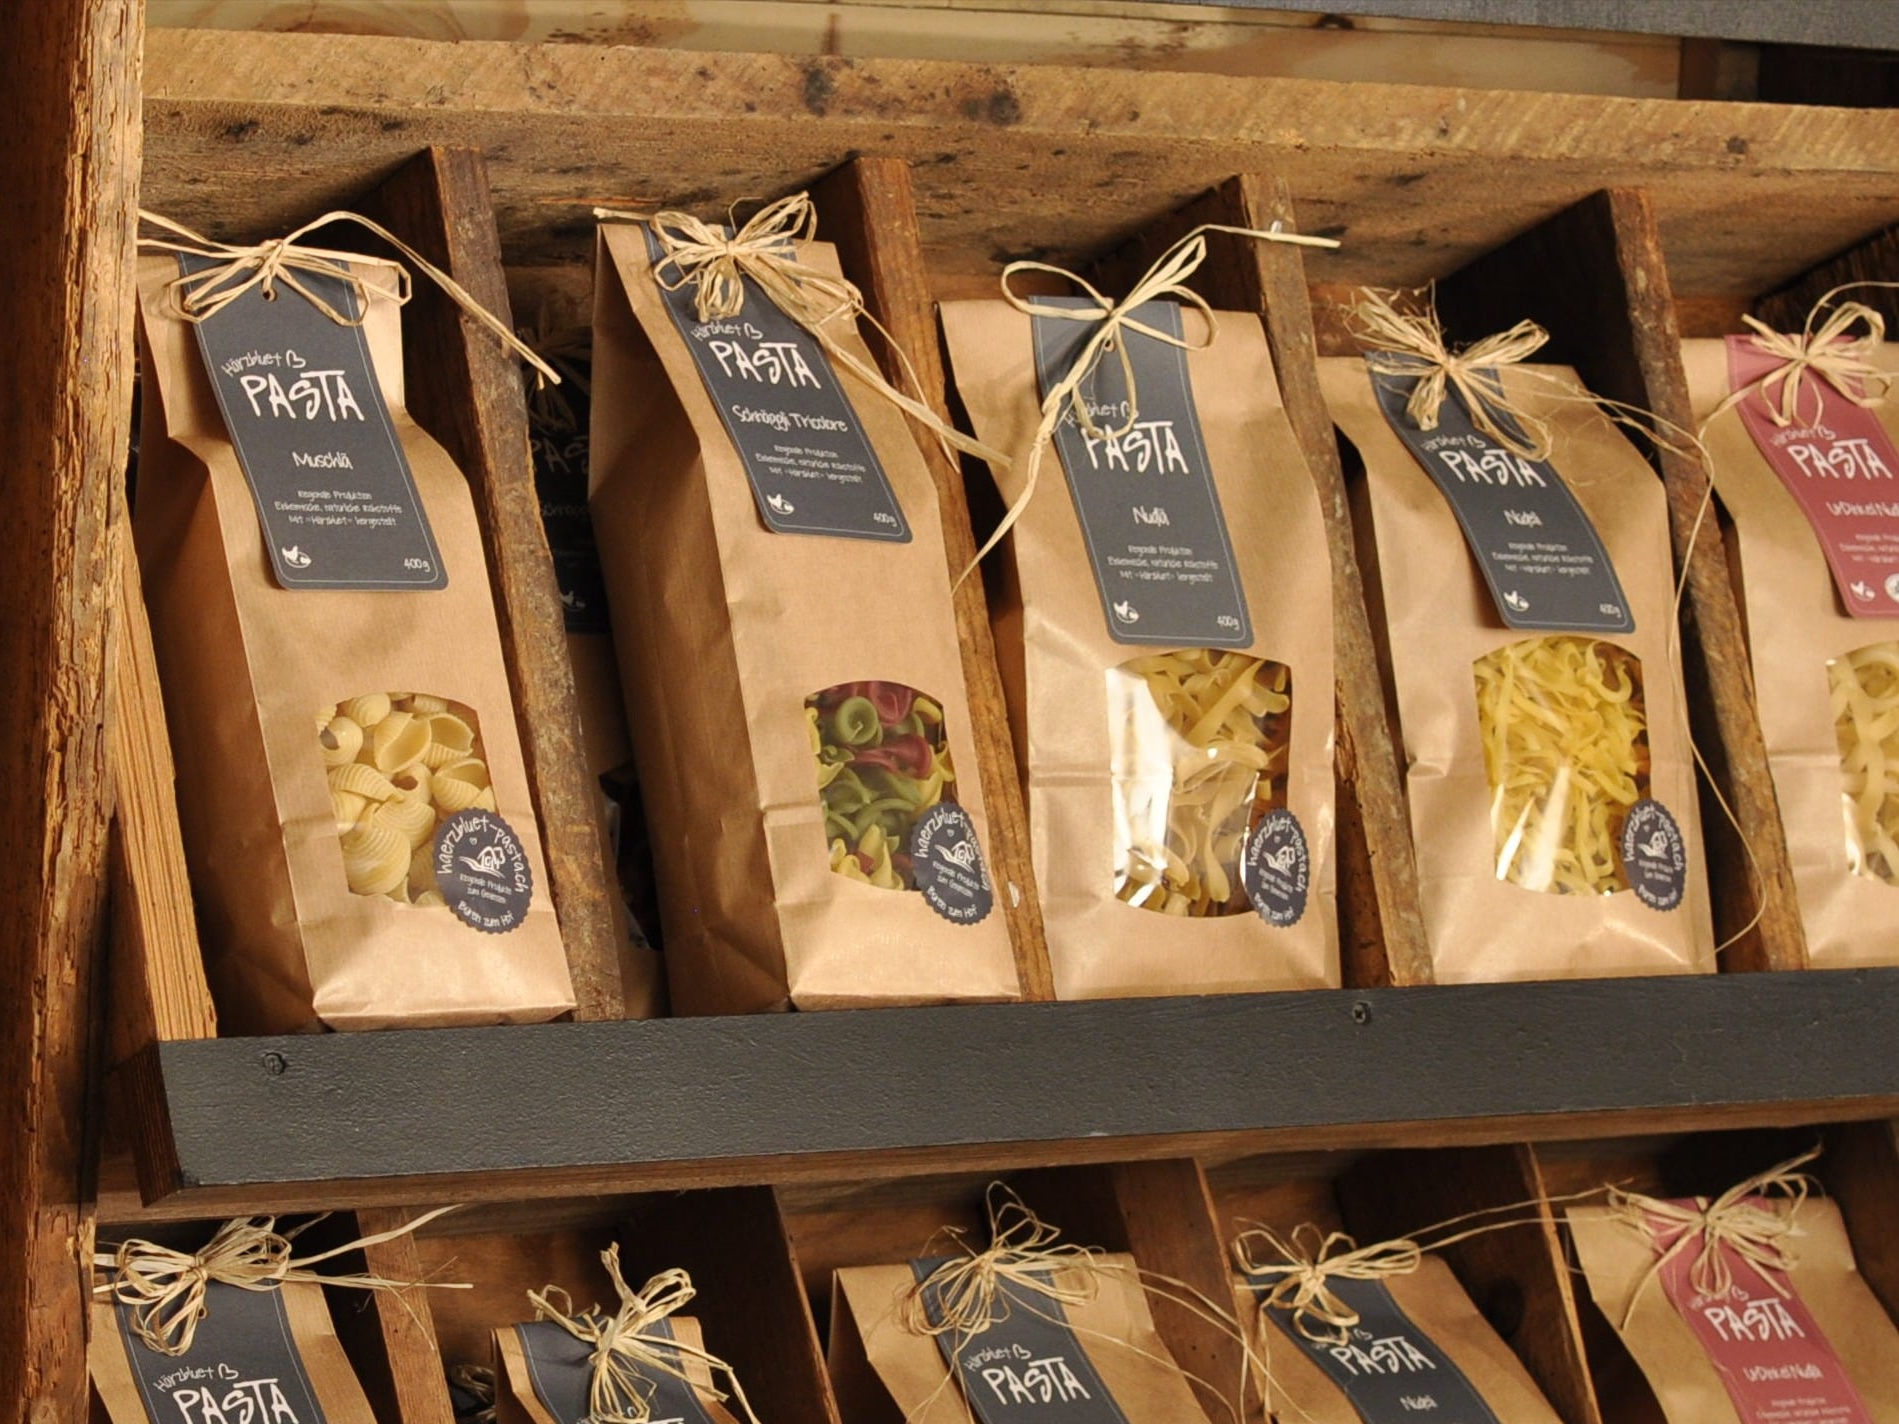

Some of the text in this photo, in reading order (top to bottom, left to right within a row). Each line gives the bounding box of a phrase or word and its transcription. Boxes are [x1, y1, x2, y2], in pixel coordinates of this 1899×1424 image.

[221, 350, 282, 377] Härzbluet
[709, 340, 822, 389] PASTA
[240, 370, 365, 422] PASTA
[292, 452, 353, 470] Muschlä
[1439, 449, 1547, 488] PASTA
[1788, 439, 1893, 479] PASTA
[1704, 1298, 1805, 1342] PASTA
[1330, 1336, 1436, 1375] PASTA
[154, 1366, 214, 1393] Härzbluet
[982, 1356, 1091, 1405] PASTA
